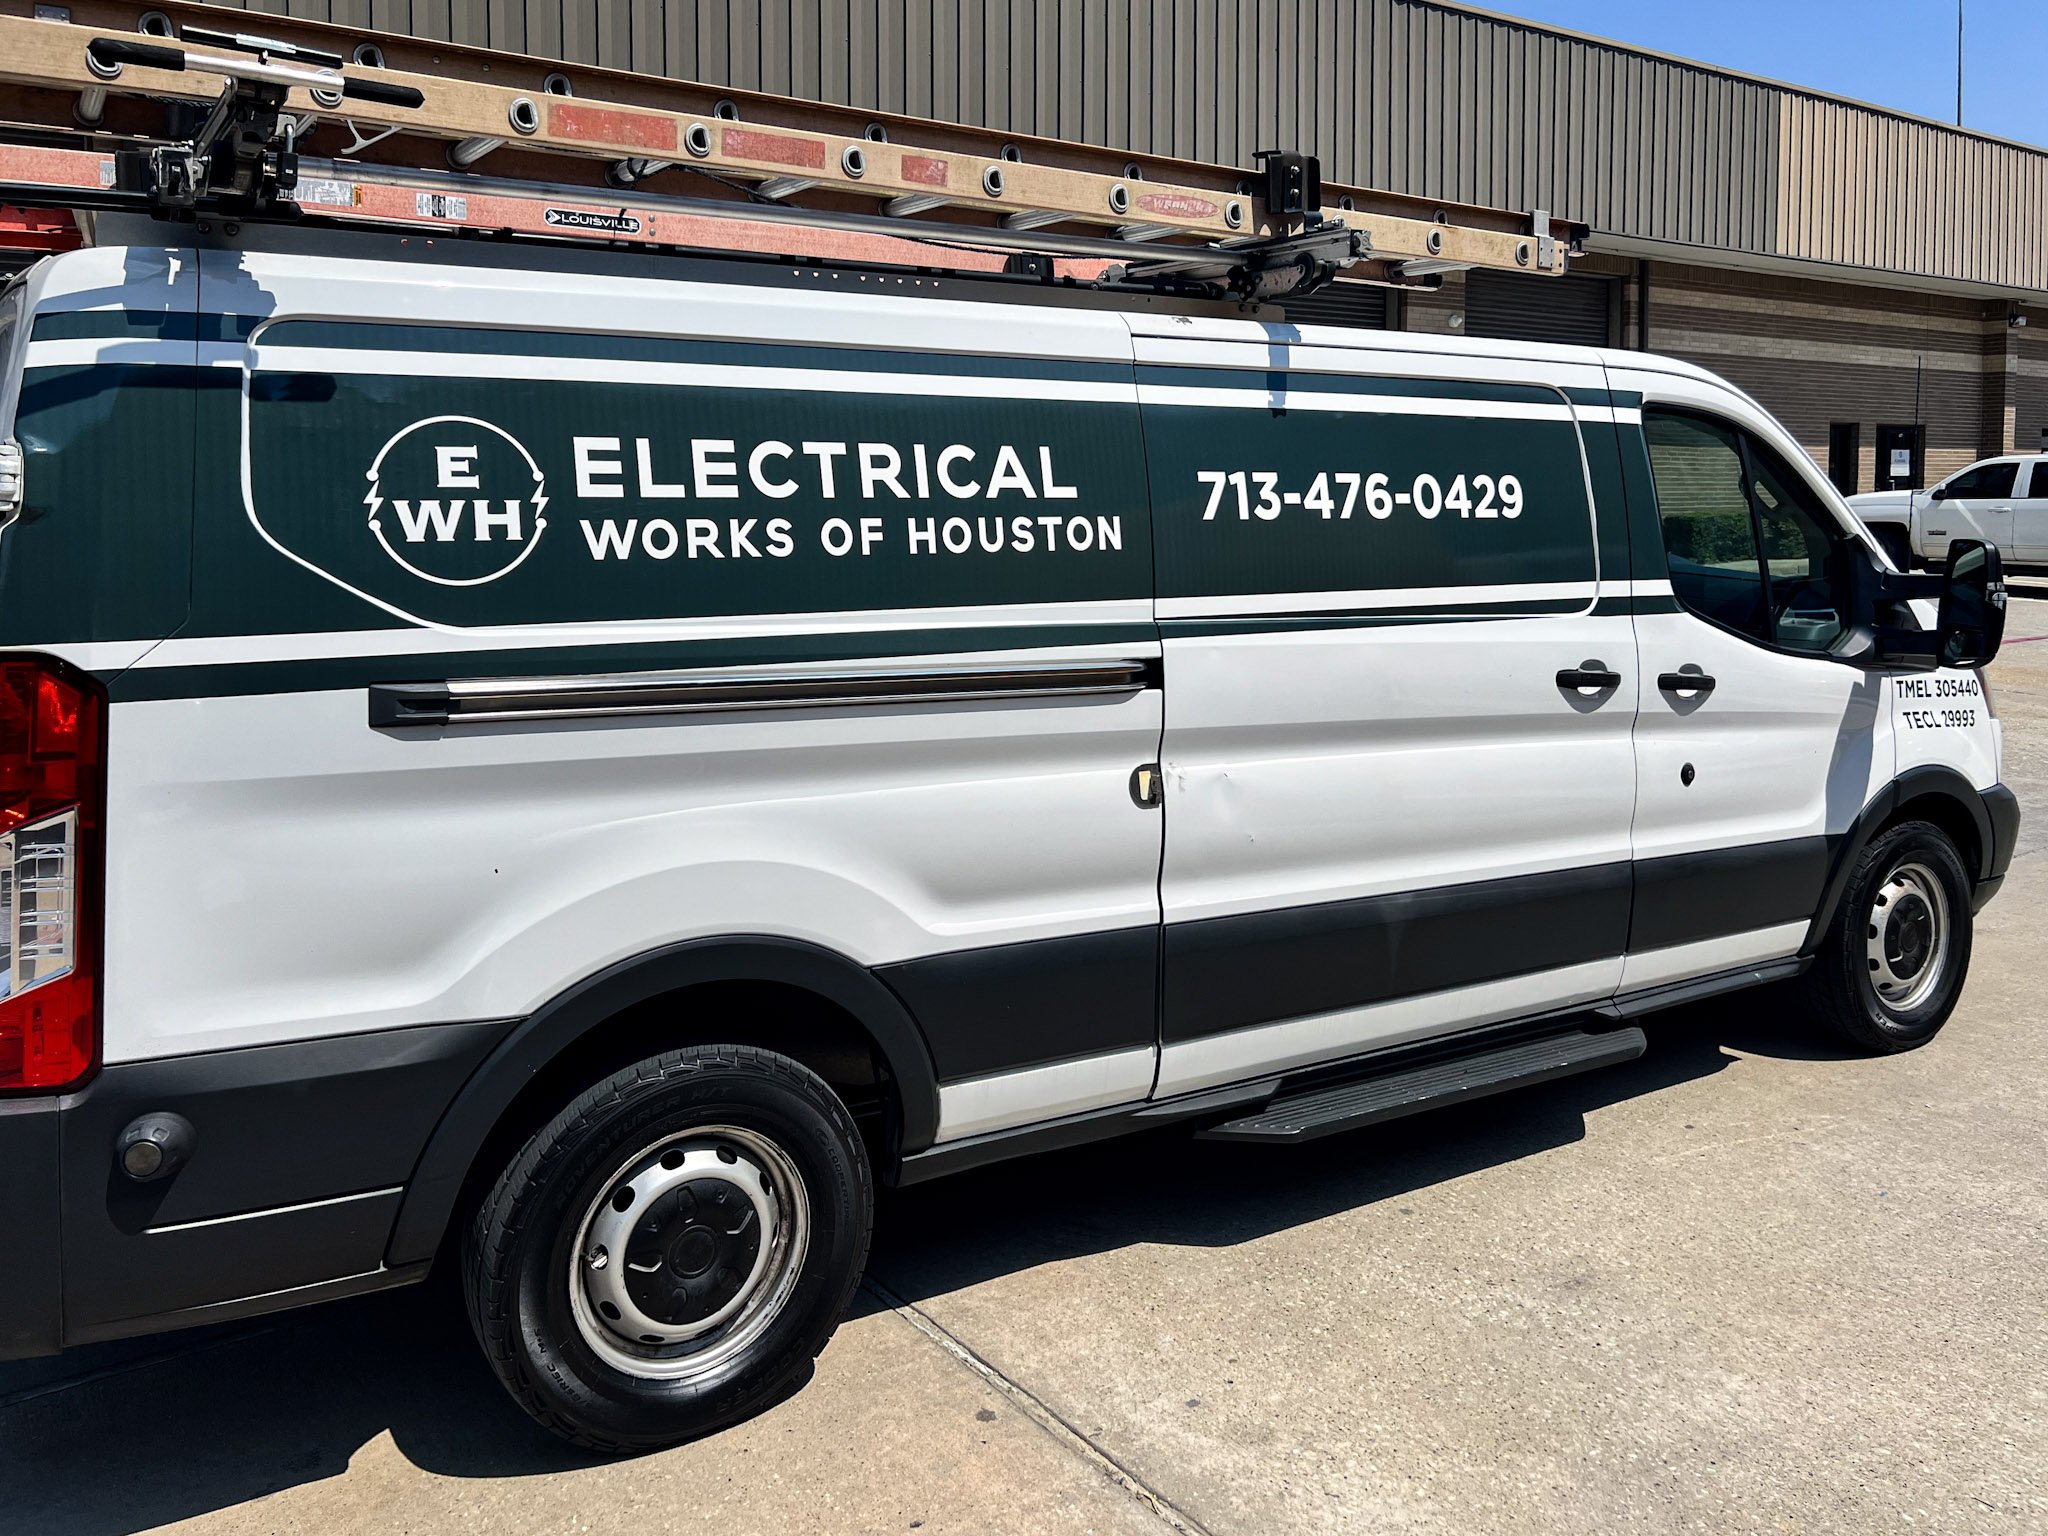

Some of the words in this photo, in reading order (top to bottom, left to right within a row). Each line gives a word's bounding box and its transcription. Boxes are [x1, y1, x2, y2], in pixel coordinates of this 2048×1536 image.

[561, 214, 638, 230] LOUISVILLE
[435, 445, 479, 489] E
[573, 437, 1077, 498] ELECTRICAL
[1197, 472, 1524, 520] 713-476-0429
[392, 500, 523, 542] WH
[580, 519, 793, 560] WORKS
[821, 518, 883, 556] OF
[908, 516, 1122, 554] HOUSTON
[1896, 680, 1932, 698] TMEL
[1935, 679, 1979, 697] 305440
[1903, 711, 1942, 729] TECL
[1941, 710, 1975, 727] 29993
